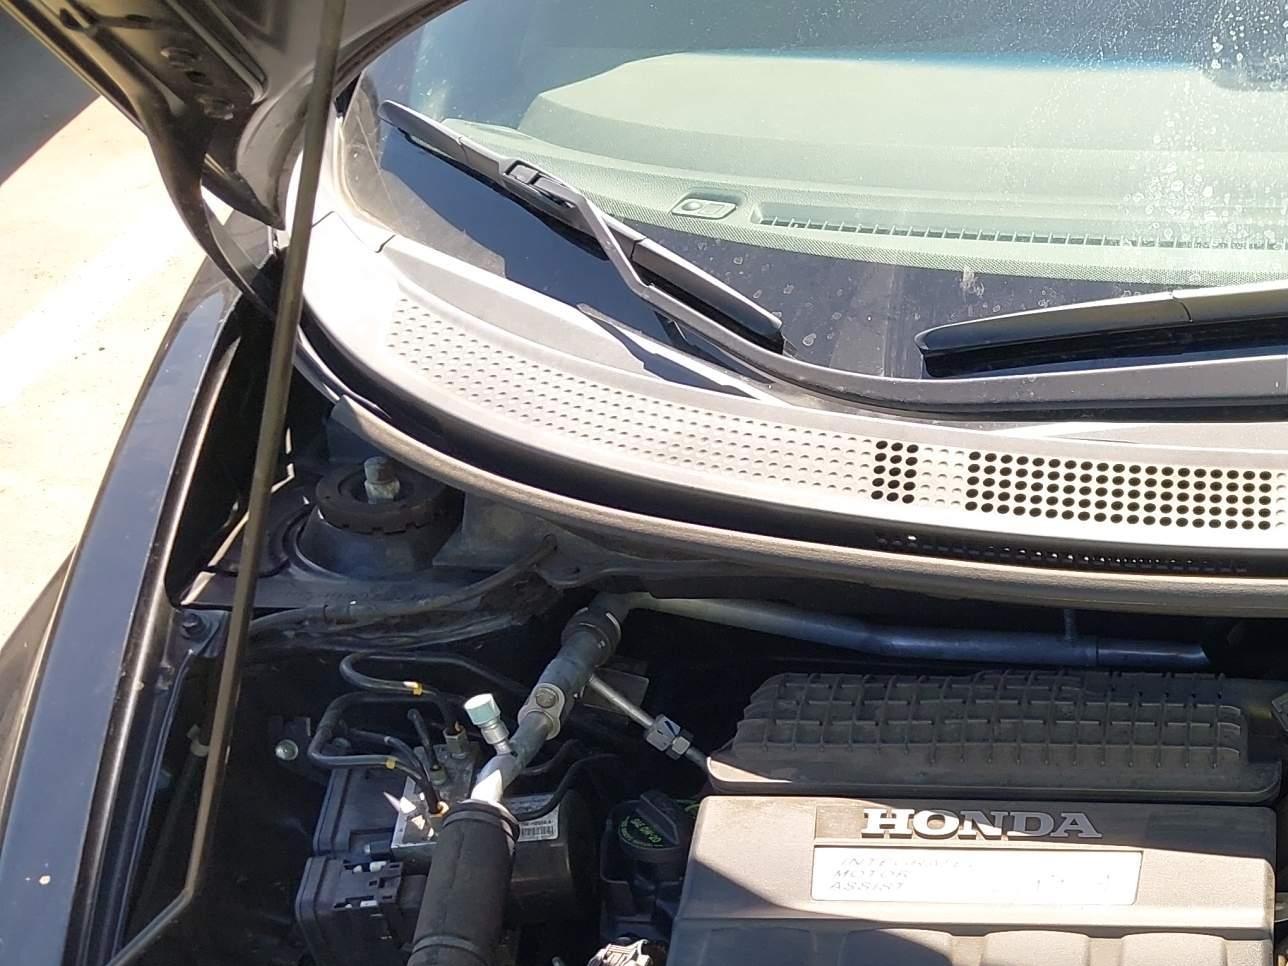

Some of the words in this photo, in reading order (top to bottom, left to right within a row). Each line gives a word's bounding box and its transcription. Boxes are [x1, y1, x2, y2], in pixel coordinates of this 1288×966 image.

[861, 808, 1103, 840] HONDA
[831, 867, 913, 880] MOTOR
[828, 880, 906, 892] ASSIST
